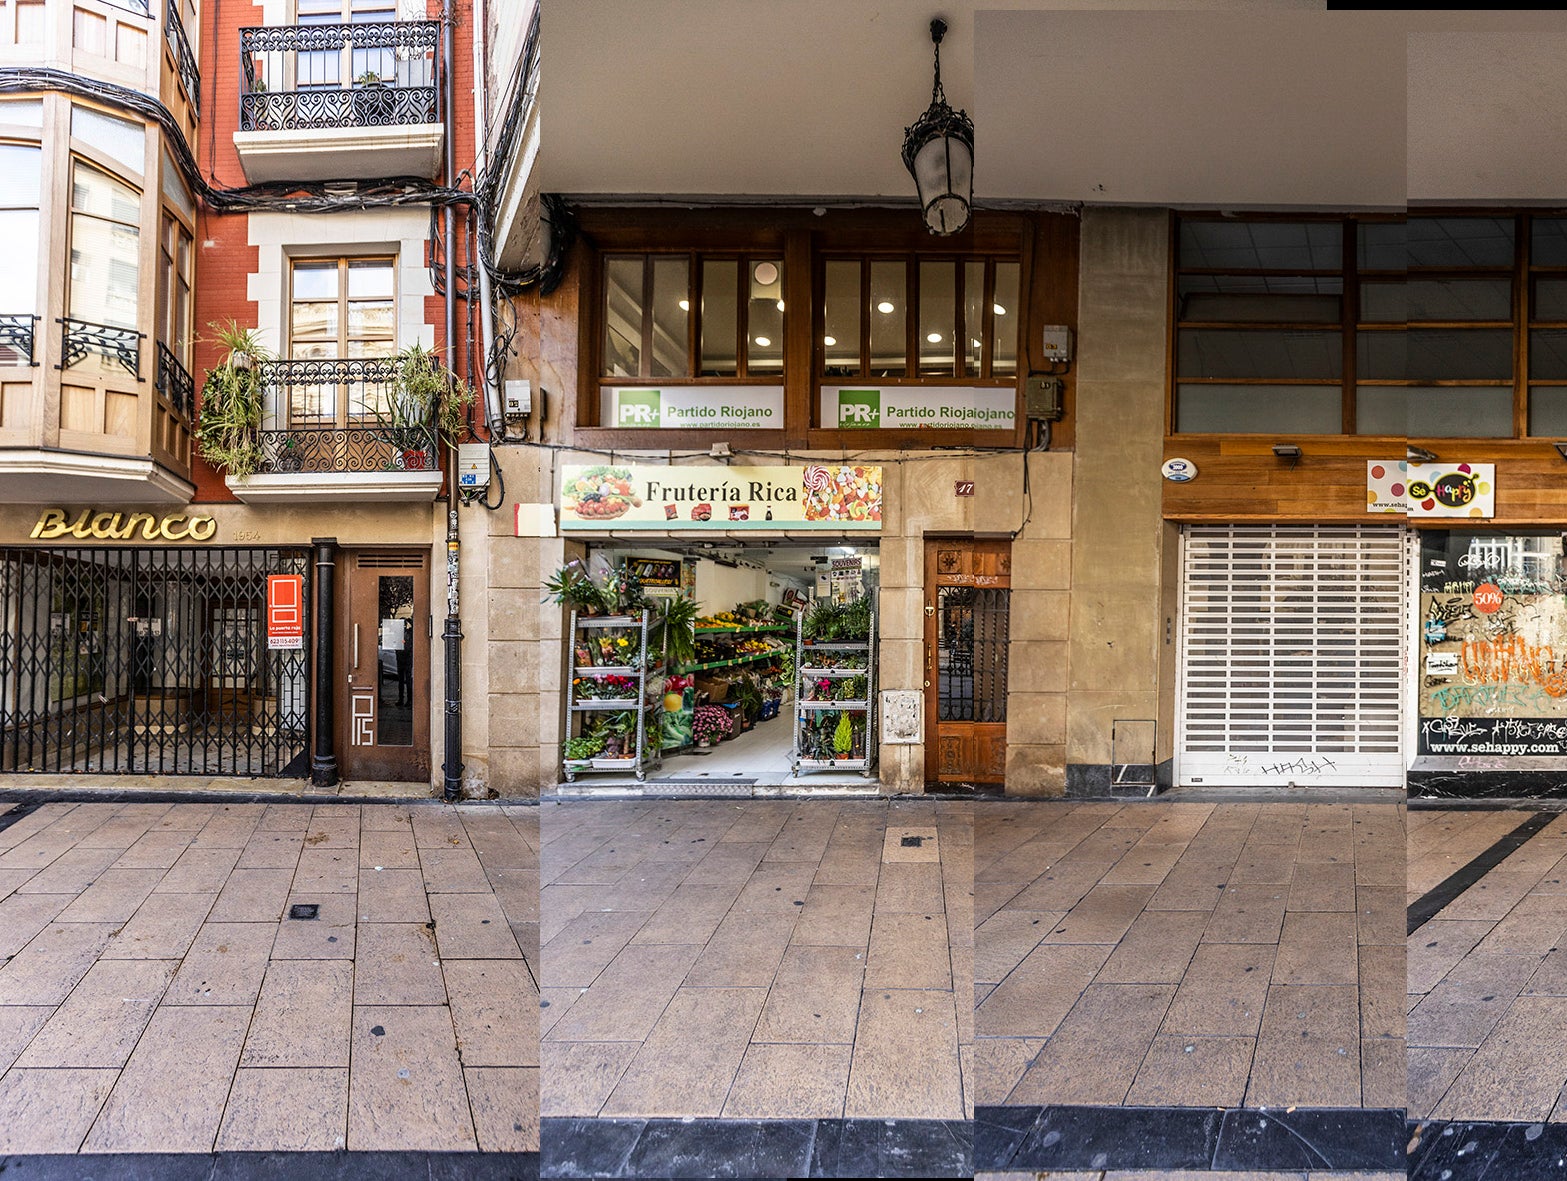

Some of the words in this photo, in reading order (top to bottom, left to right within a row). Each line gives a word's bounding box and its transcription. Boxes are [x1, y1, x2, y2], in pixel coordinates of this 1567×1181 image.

[667, 406, 717, 418] Partido
[720, 405, 773, 420] Riojano
[886, 406, 936, 418] Partido
[646, 481, 741, 502] Frutería
[748, 481, 797, 502] Rica
[958, 483, 974, 494] 17
[1436, 484, 1472, 503] Happy
[29, 508, 218, 541] Blanco
[1475, 593, 1503, 605] 50%
[1430, 742, 1560, 755] www.sehappy.com
